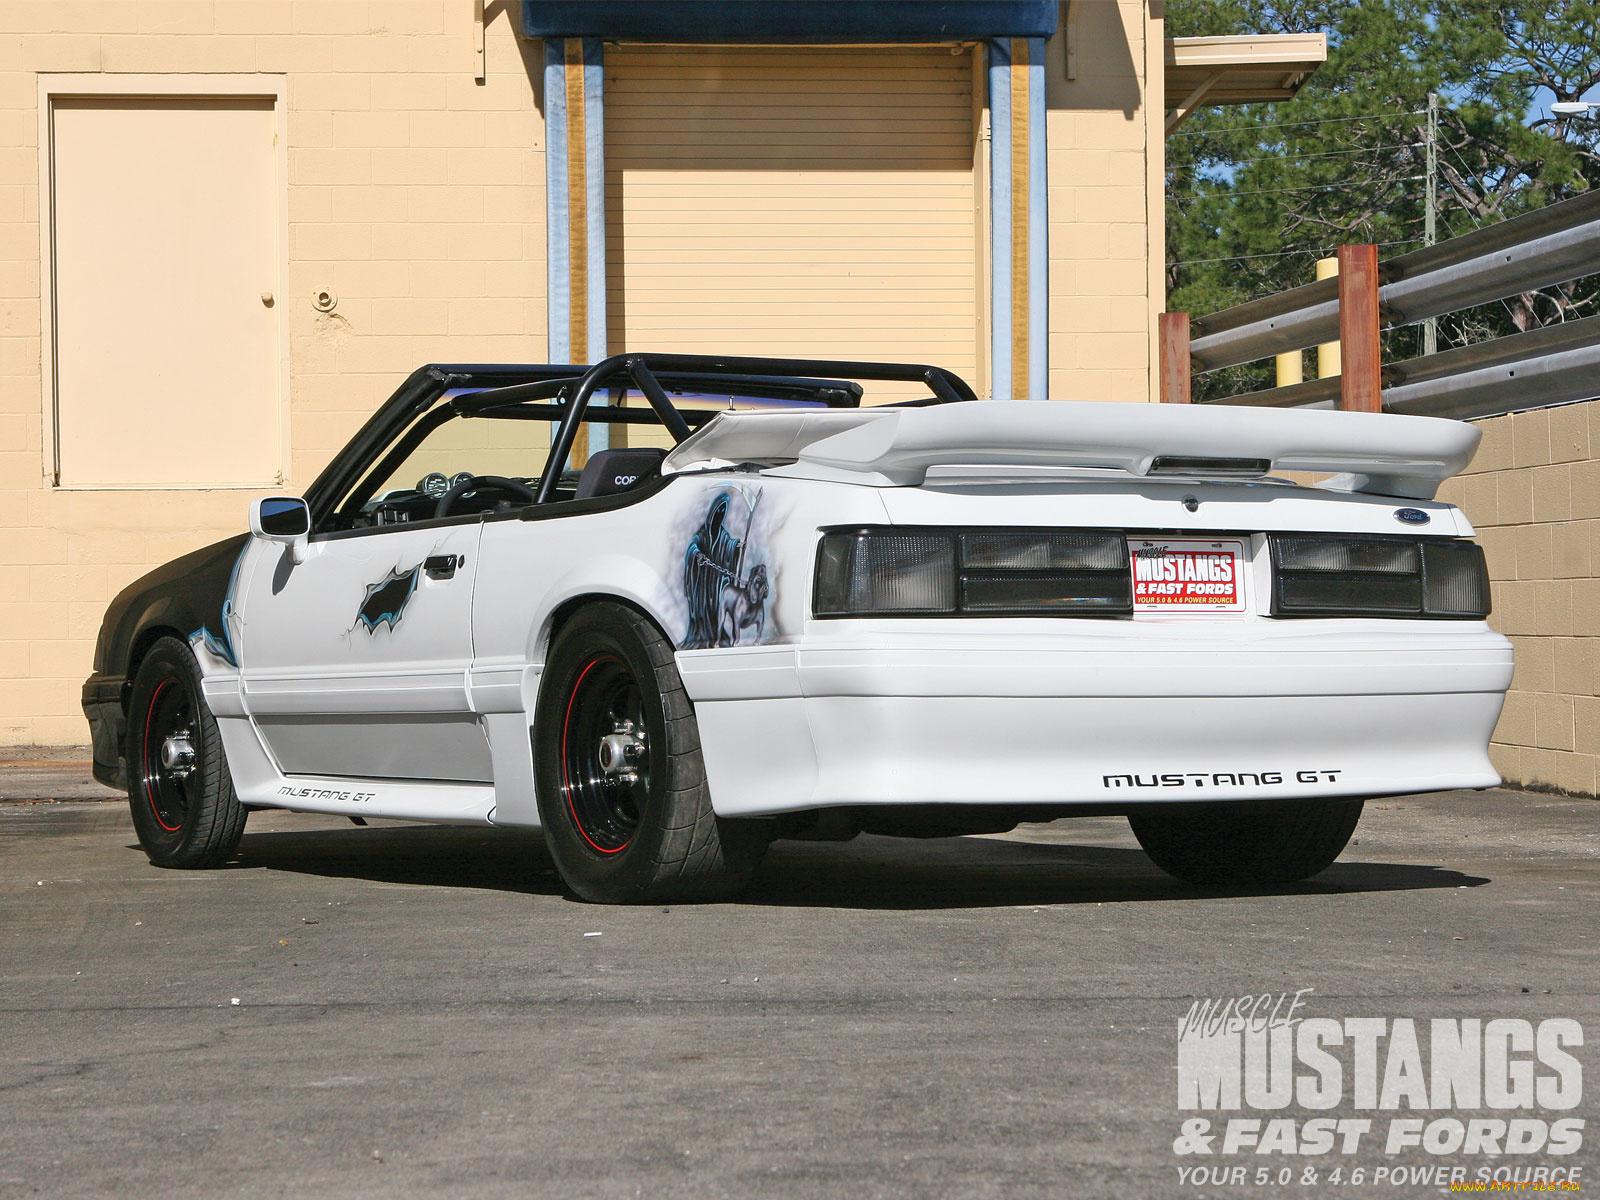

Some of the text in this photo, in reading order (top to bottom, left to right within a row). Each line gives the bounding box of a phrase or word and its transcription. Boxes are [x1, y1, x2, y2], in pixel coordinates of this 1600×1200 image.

[1136, 554, 1233, 582] MUSTANGS
[1136, 583, 1234, 595] & FAST FORDS
[1103, 770, 1342, 788] MUSTANG GT
[277, 786, 376, 802] MUSTANG GT
